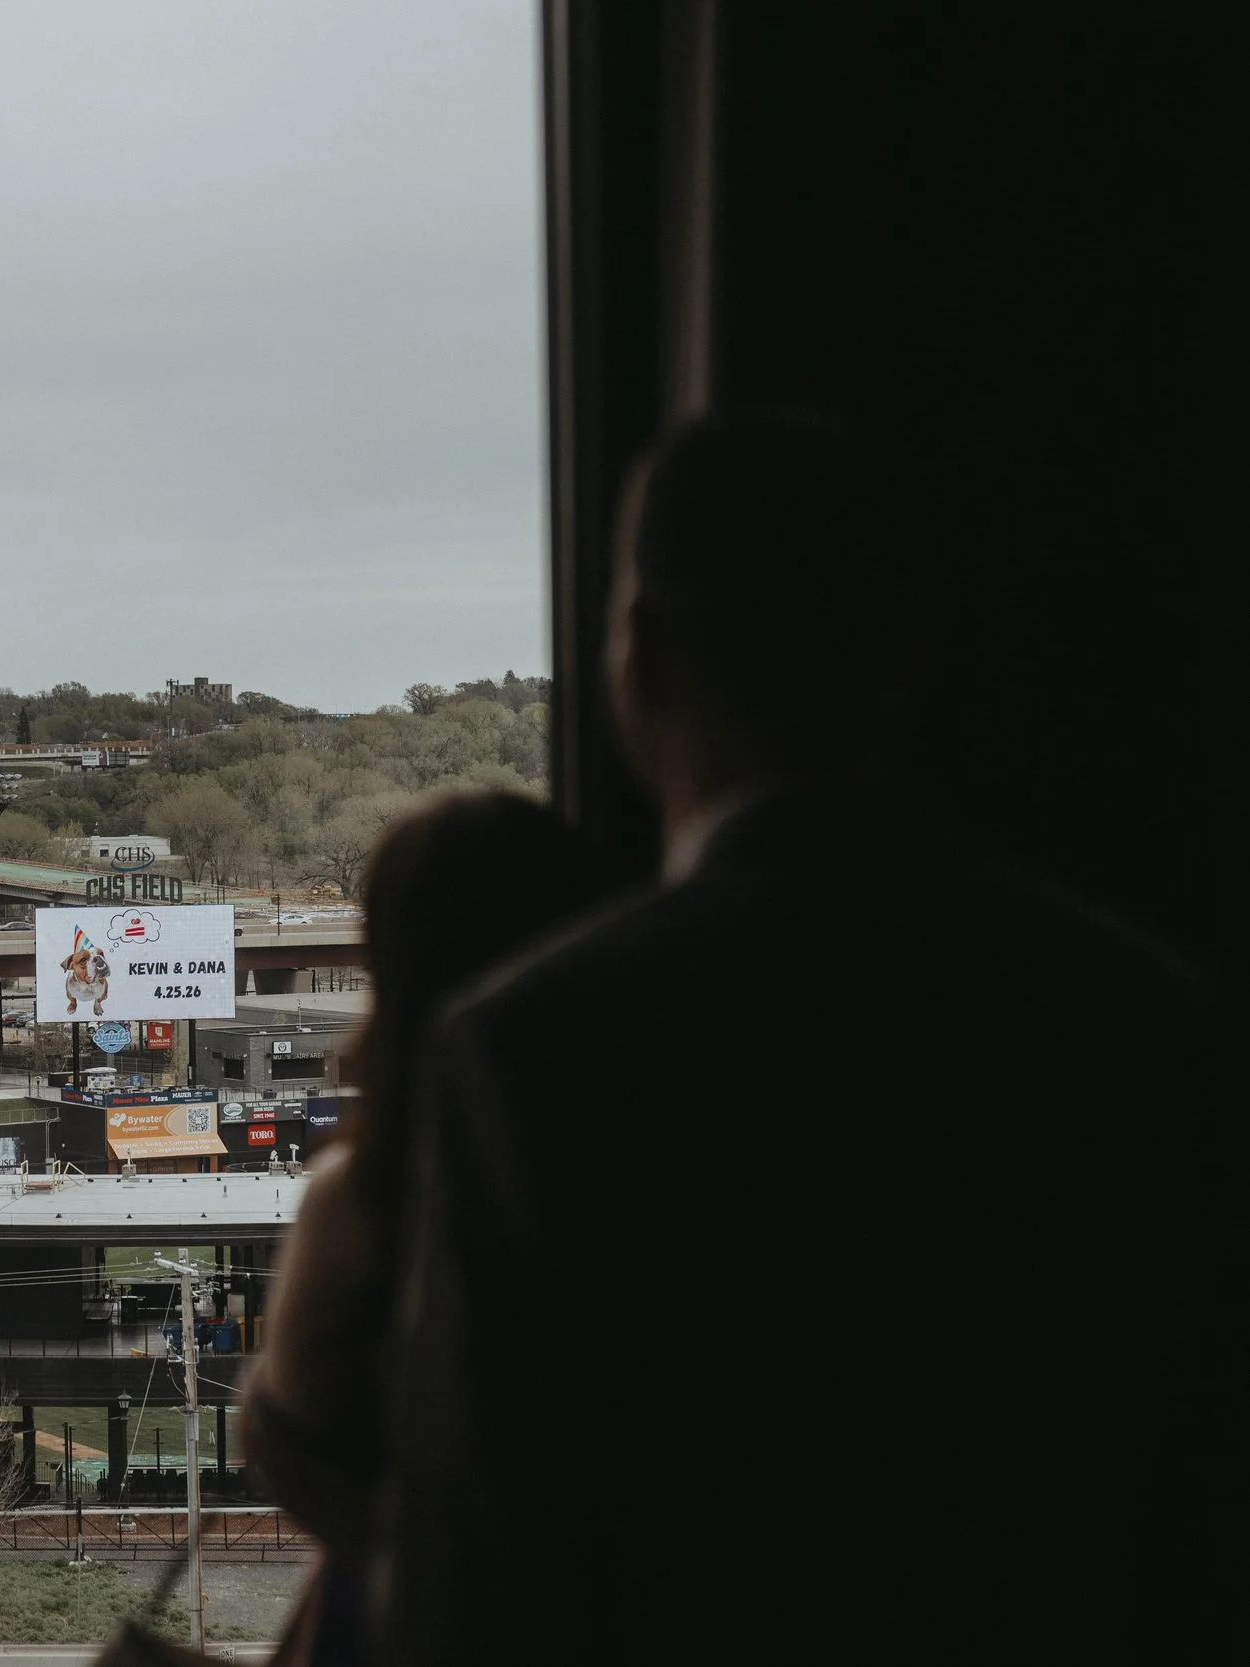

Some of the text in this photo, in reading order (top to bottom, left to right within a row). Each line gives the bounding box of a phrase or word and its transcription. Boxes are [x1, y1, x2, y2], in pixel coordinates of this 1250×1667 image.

[115, 846, 151, 861] CHS
[86, 873, 183, 905] CHS FIELD
[129, 960, 226, 975] KEVIN & DANA
[154, 985, 201, 999] 4.25.26
[93, 1028, 131, 1043] Saints
[127, 1114, 163, 1125] Bywater
[310, 1116, 338, 1124] Quantum
[250, 1130, 273, 1140] TORO
[220, 1649, 233, 1657] ONE
